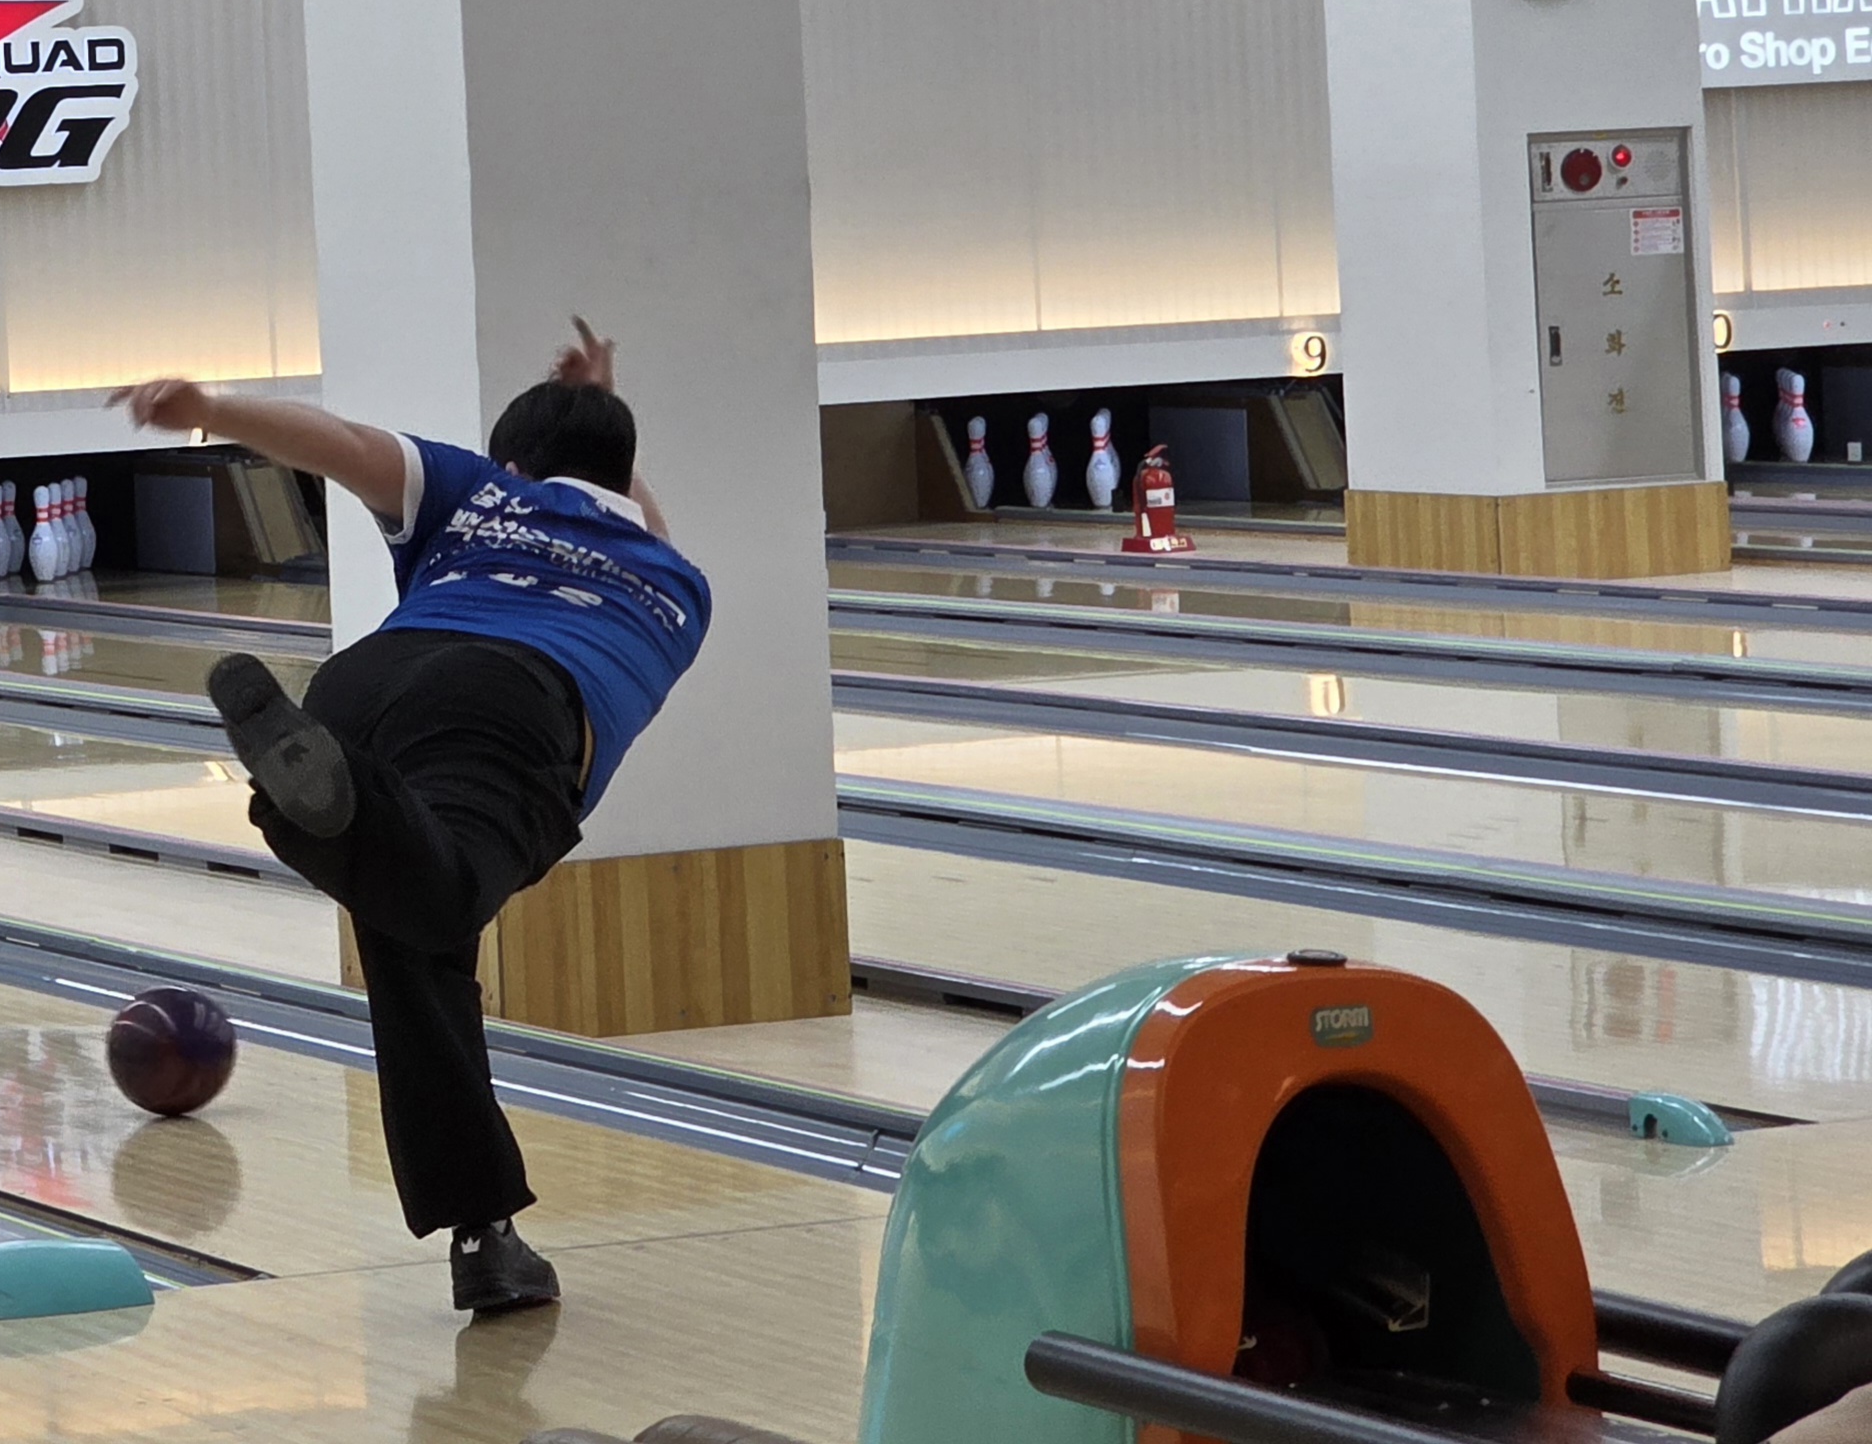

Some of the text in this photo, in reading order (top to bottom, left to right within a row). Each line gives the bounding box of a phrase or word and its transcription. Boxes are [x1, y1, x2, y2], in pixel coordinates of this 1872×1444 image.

[1739, 31, 1836, 75] Shop
[1845, 26, 1872, 64] E
[1303, 335, 1327, 374] 9
[1315, 1007, 1369, 1032] STORM
